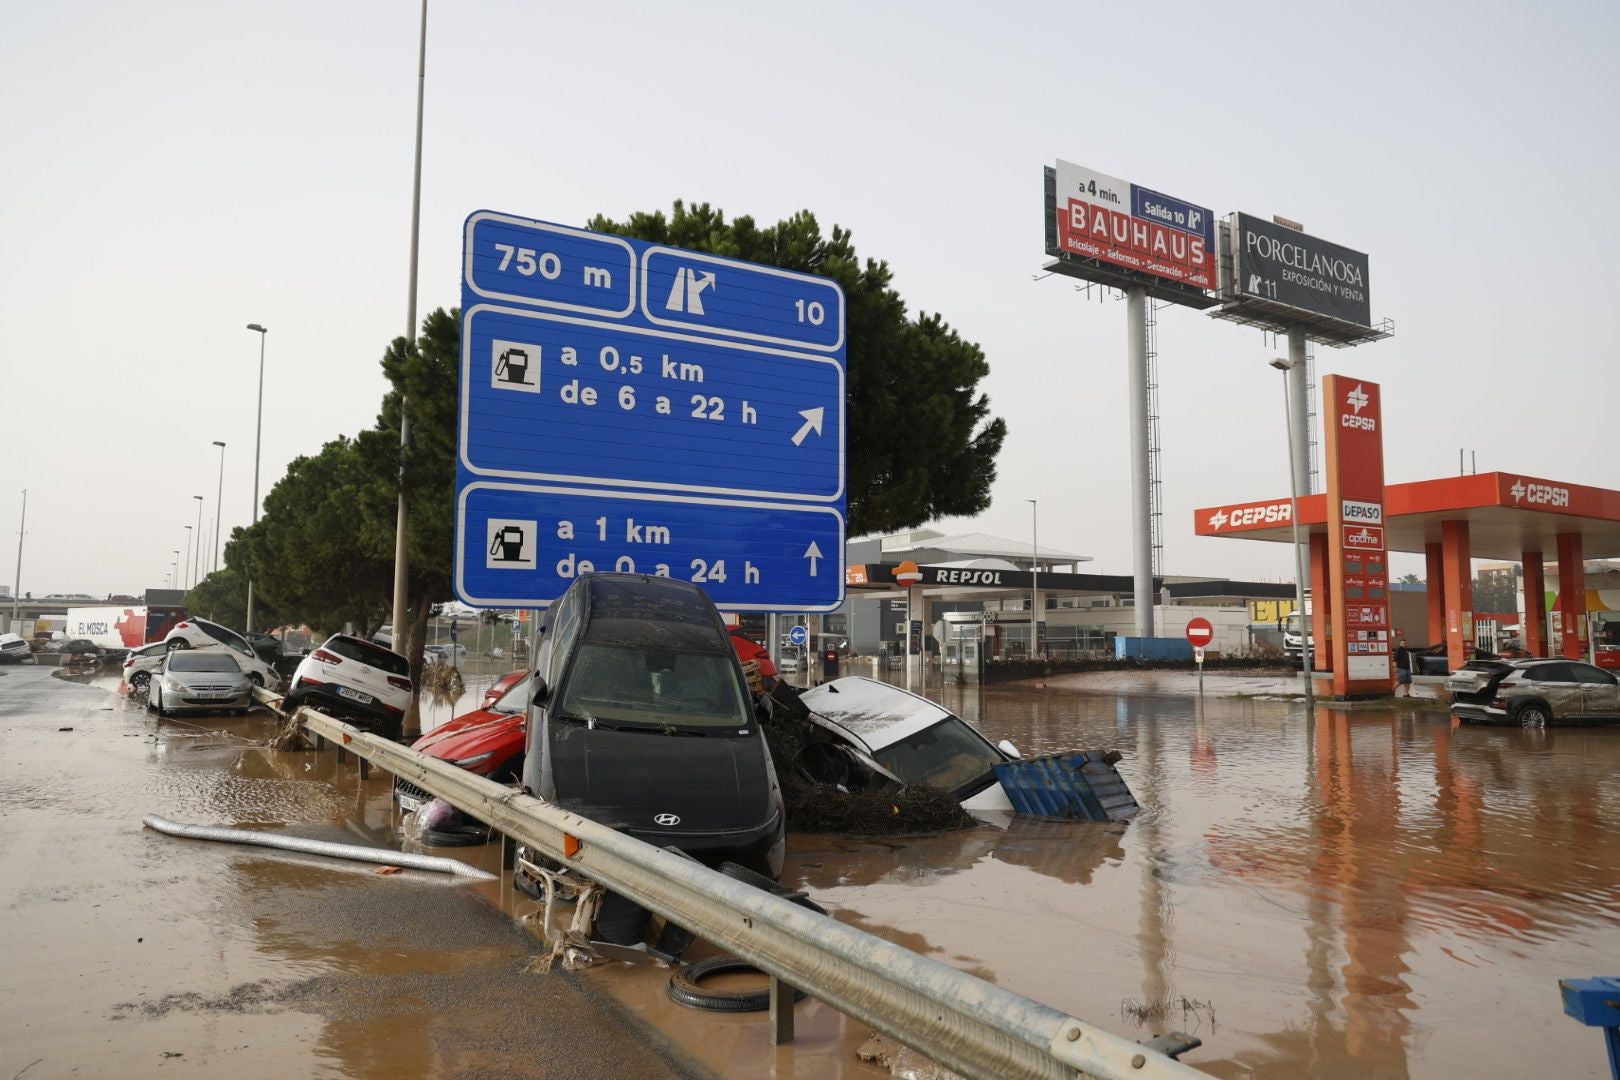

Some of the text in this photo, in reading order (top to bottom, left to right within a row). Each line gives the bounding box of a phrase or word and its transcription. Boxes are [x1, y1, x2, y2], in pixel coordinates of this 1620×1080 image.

[1079, 179, 1120, 204] a 4 min.
[1145, 202, 1185, 225] Salida 10
[1072, 203, 1205, 265] BAUHAUS
[494, 243, 612, 289] 750 m
[1068, 238, 1100, 256] Bricolaje
[1107, 249, 1140, 266] Reformas
[1147, 260, 1183, 278] Decoración
[1247, 231, 1364, 288] PORCELANOSA
[1265, 279, 1277, 299] 11
[1282, 269, 1364, 302] EXPOSICIÓN Y VENTA
[795, 298, 825, 326] 10
[560, 343, 704, 383] a 0,5 km
[560, 379, 757, 425] de 6 a 22 h
[1342, 414, 1376, 431] CEPSA
[1528, 483, 1569, 507] CEPSA
[1230, 504, 1292, 526] CEPSA
[1345, 505, 1380, 519] DEPASO
[557, 516, 671, 545] a 1 km
[1349, 534, 1378, 546] optima
[556, 553, 760, 584] de 0 a 24 h
[936, 569, 1002, 585] REPSOL
[79, 622, 108, 635] EL MOSCA
[513, 621, 519, 629] P
